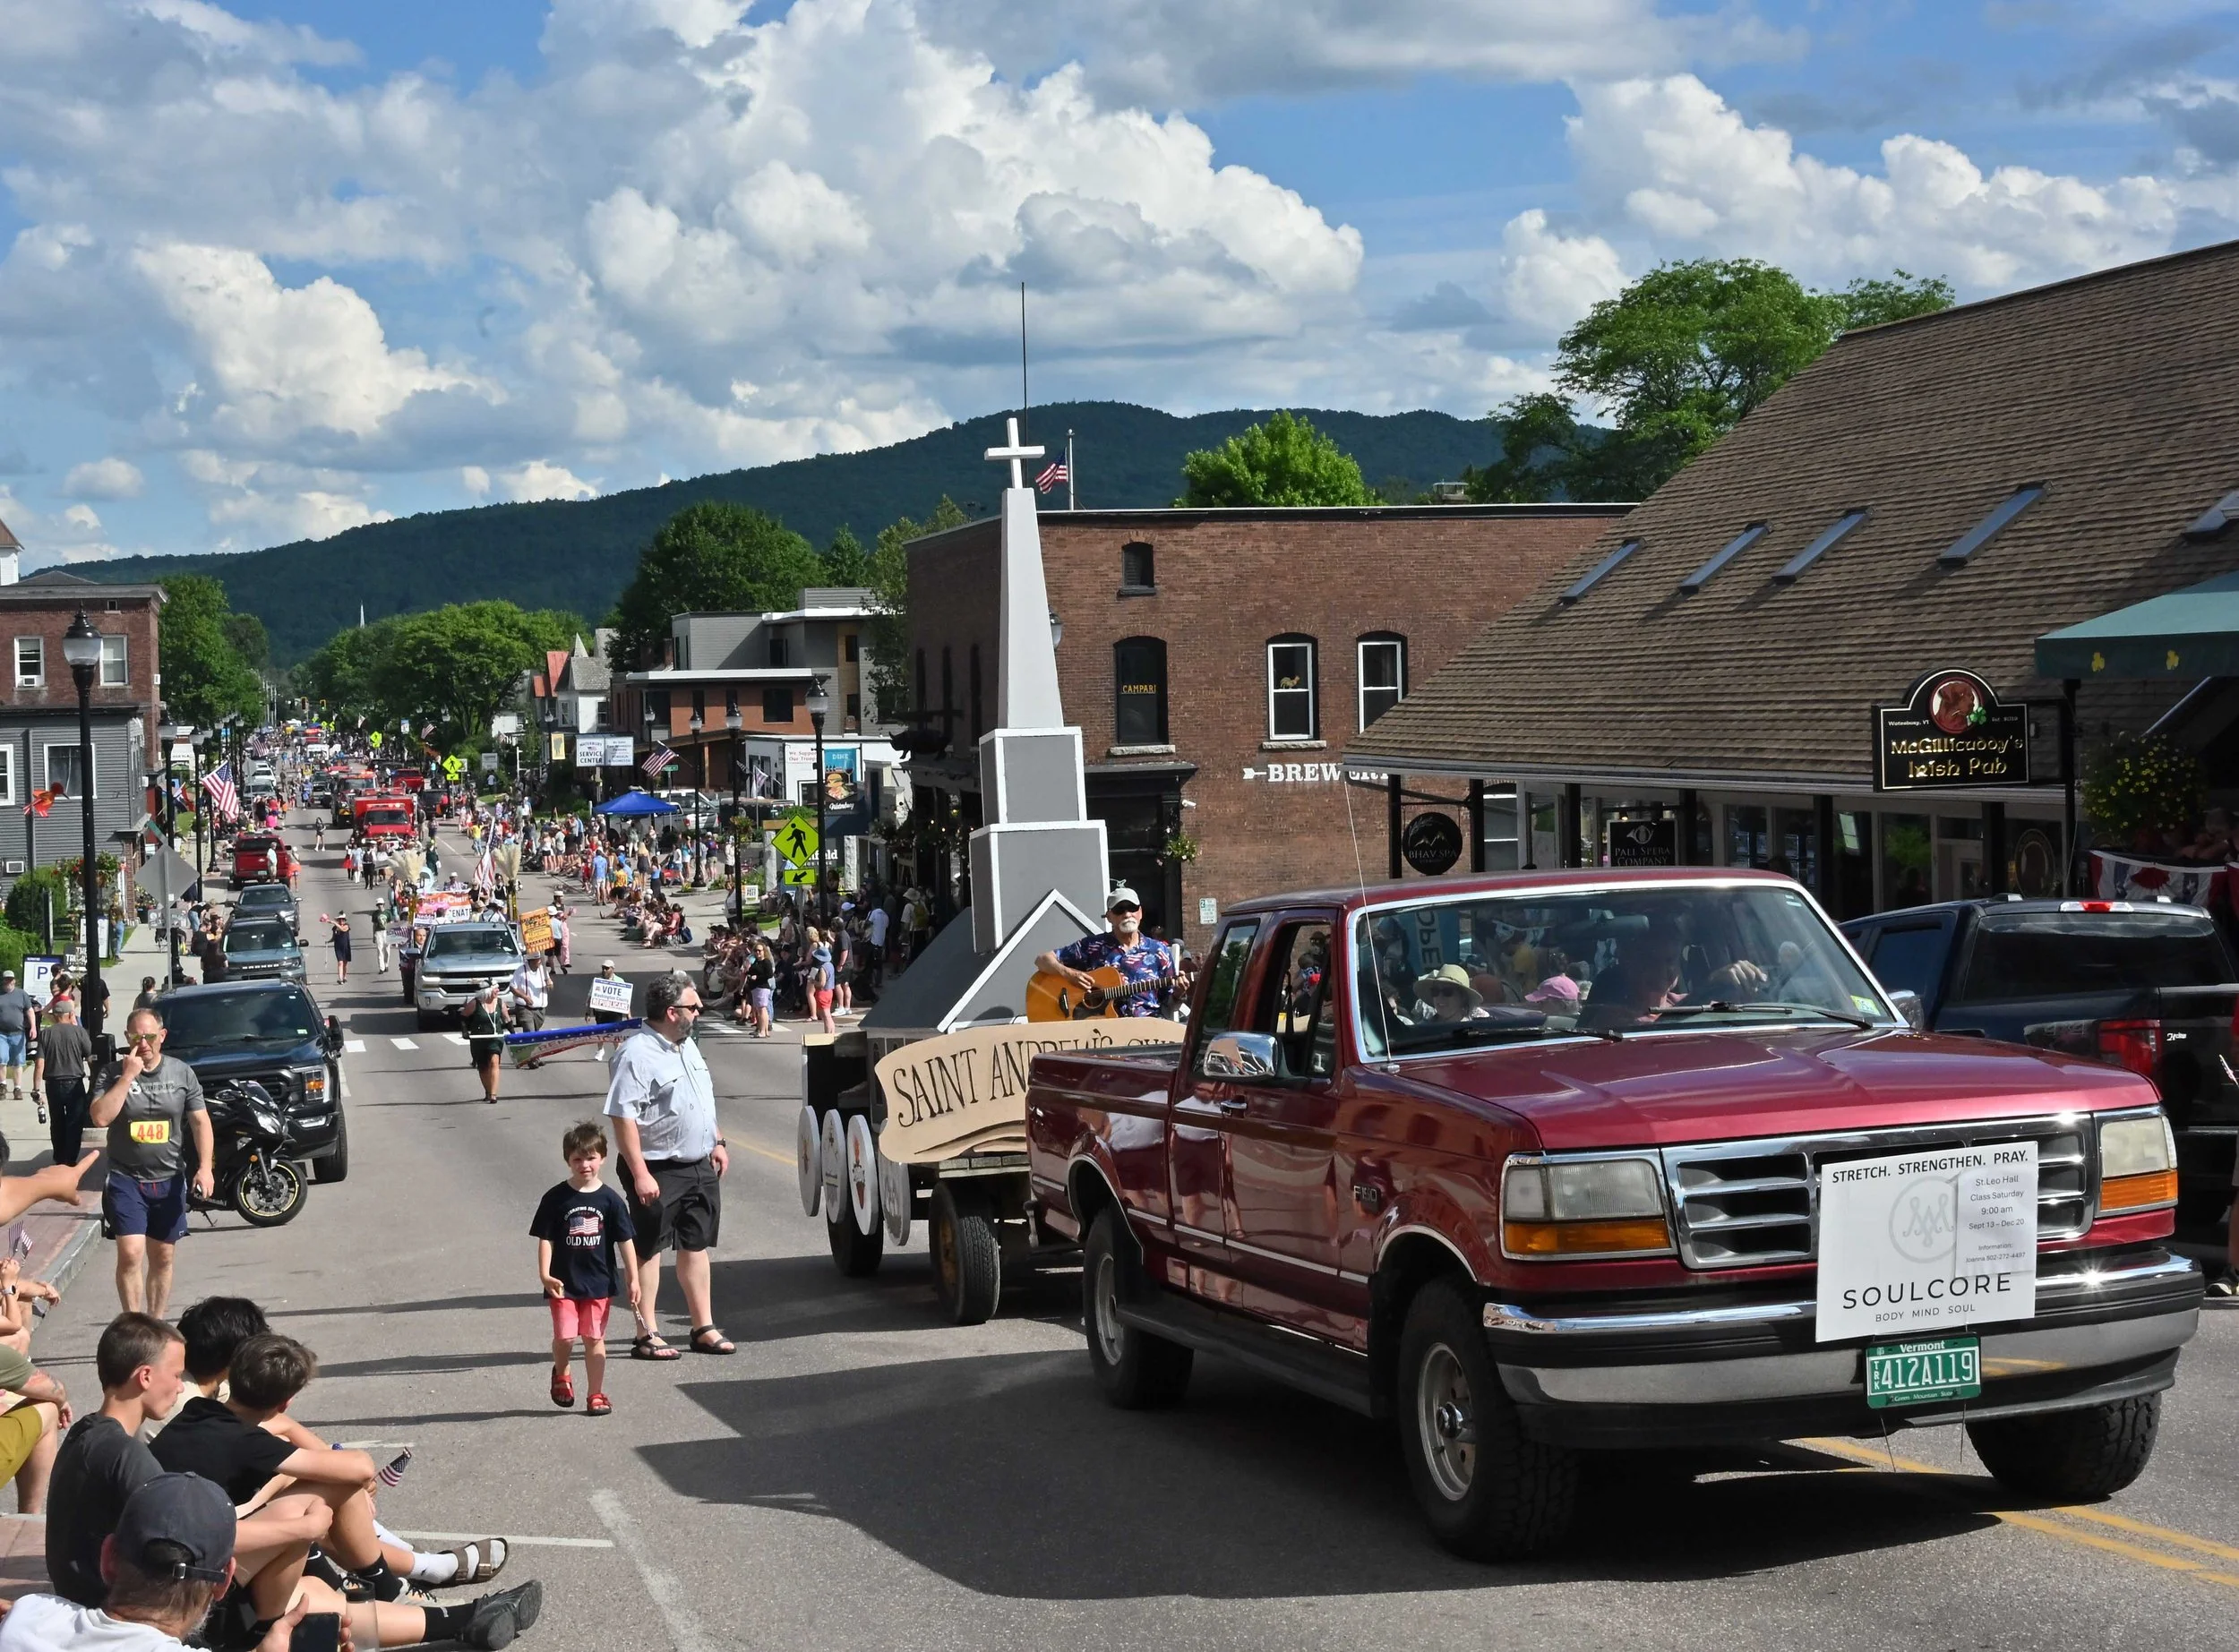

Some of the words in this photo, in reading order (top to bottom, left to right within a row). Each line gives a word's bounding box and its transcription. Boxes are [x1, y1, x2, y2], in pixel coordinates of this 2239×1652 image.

[1122, 684, 1155, 693] CAMPARI
[1891, 735, 2023, 754] McGillicuddy's
[1909, 758, 1960, 778] Irish
[1969, 757, 2007, 775] Pub
[1409, 850, 1437, 859] BHAV
[1439, 849, 1456, 858] SPA
[1617, 855, 1668, 867] COMPANY
[38, 966, 47, 980] P
[602, 986, 622, 997] VOTE
[894, 1048, 977, 1127] SAINT
[137, 1124, 164, 1140] 448
[1832, 1165, 1891, 1184] STRETCH.
[1898, 1154, 1986, 1175] STRENGTHEN.
[1994, 1150, 2029, 1164] PRAY.
[2003, 1175, 2019, 1183] Hall
[1970, 1193, 1991, 1202] Class
[1992, 1190, 2025, 1201] Saturday
[1981, 1206, 1999, 1215] 9:00
[2000, 1206, 2013, 1214] am
[1969, 1221, 1985, 1231] Sept
[2001, 1219, 2014, 1227] Dec
[2015, 1217, 2025, 1226] 20
[566, 1236, 582, 1245] OLD
[582, 1235, 601, 1245] NAVY
[1842, 1271, 2012, 1310] SOULCORE
[1875, 1311, 1905, 1322] BODY
[1912, 1307, 1941, 1319] MIND
[1948, 1304, 1976, 1315] SOUL
[1900, 1340, 1945, 1353] Vermont
[1881, 1351, 1973, 1389] 412A119
